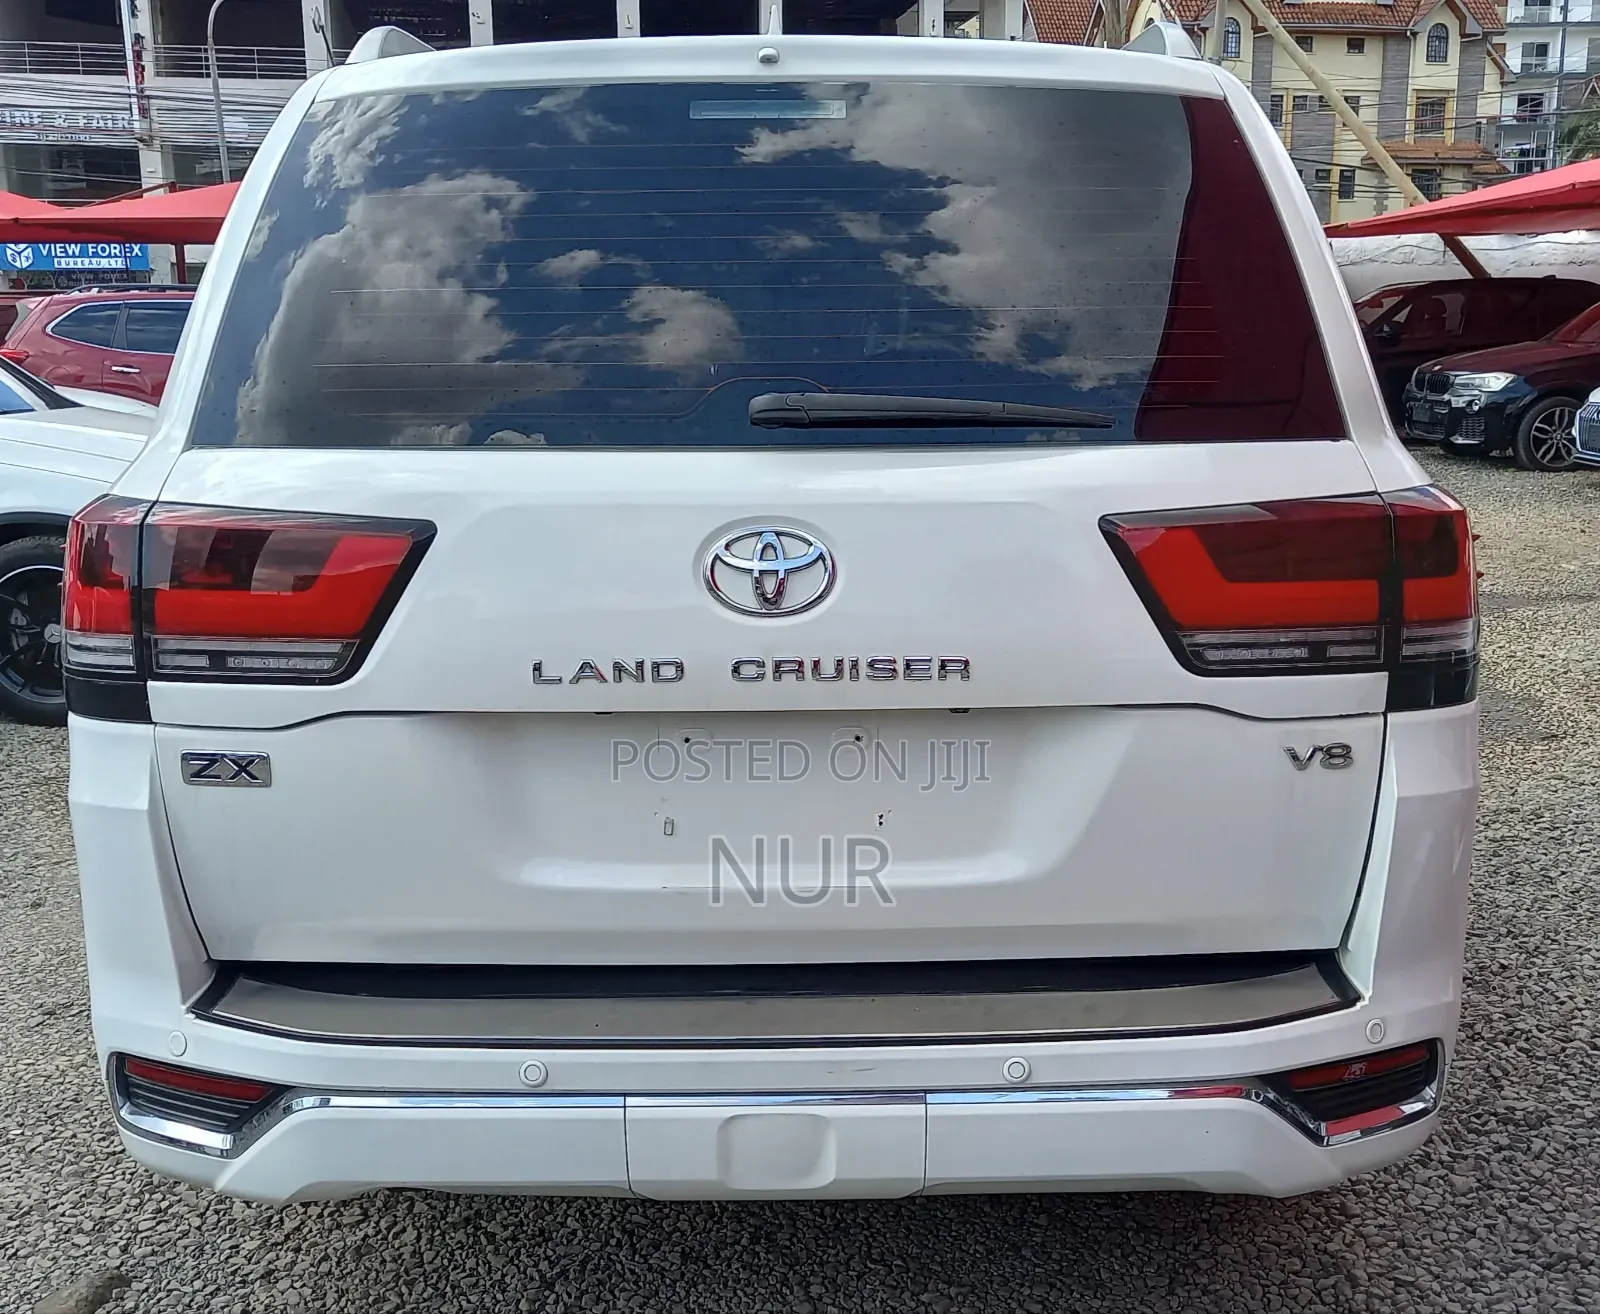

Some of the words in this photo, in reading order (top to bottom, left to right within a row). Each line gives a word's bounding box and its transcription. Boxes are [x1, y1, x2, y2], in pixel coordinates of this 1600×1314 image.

[38, 243, 80, 257] VIEW
[88, 243, 143, 257] FOREX
[56, 259, 102, 267] BUREAU
[107, 259, 127, 267] LTD
[532, 657, 684, 684] LAND
[730, 655, 971, 682] CRUISER
[188, 756, 264, 782] ZX
[1282, 742, 1354, 771] V8
